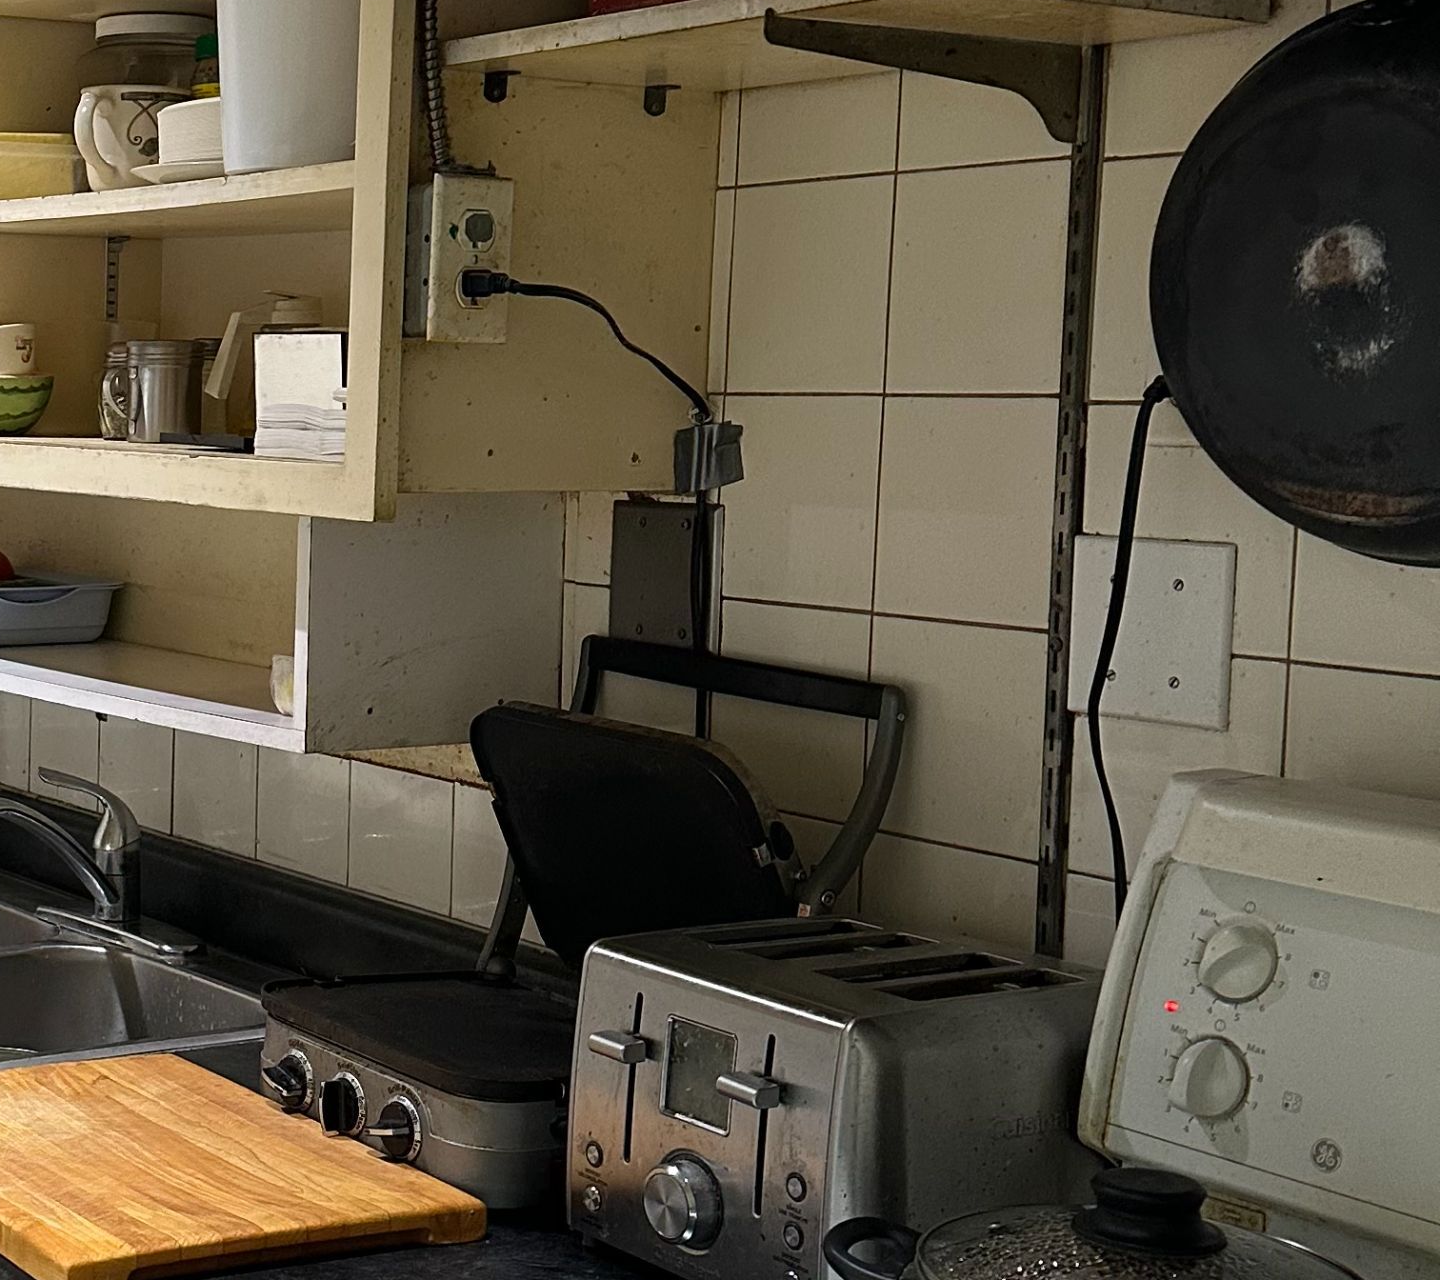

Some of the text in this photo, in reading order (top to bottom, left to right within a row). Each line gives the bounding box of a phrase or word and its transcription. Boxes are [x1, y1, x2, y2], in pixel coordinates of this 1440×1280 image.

[1199, 907, 1217, 918] Min
[1276, 923, 1296, 935] Max
[1183, 952, 1291, 967] 2 8
[1278, 981, 1285, 989] 7
[1259, 1004, 1265, 1012] 6
[1234, 1013, 1240, 1022] 5
[1170, 1024, 1188, 1036] Min
[1246, 1043, 1266, 1056] Max
[1158, 1074, 1264, 1084] 2 8
